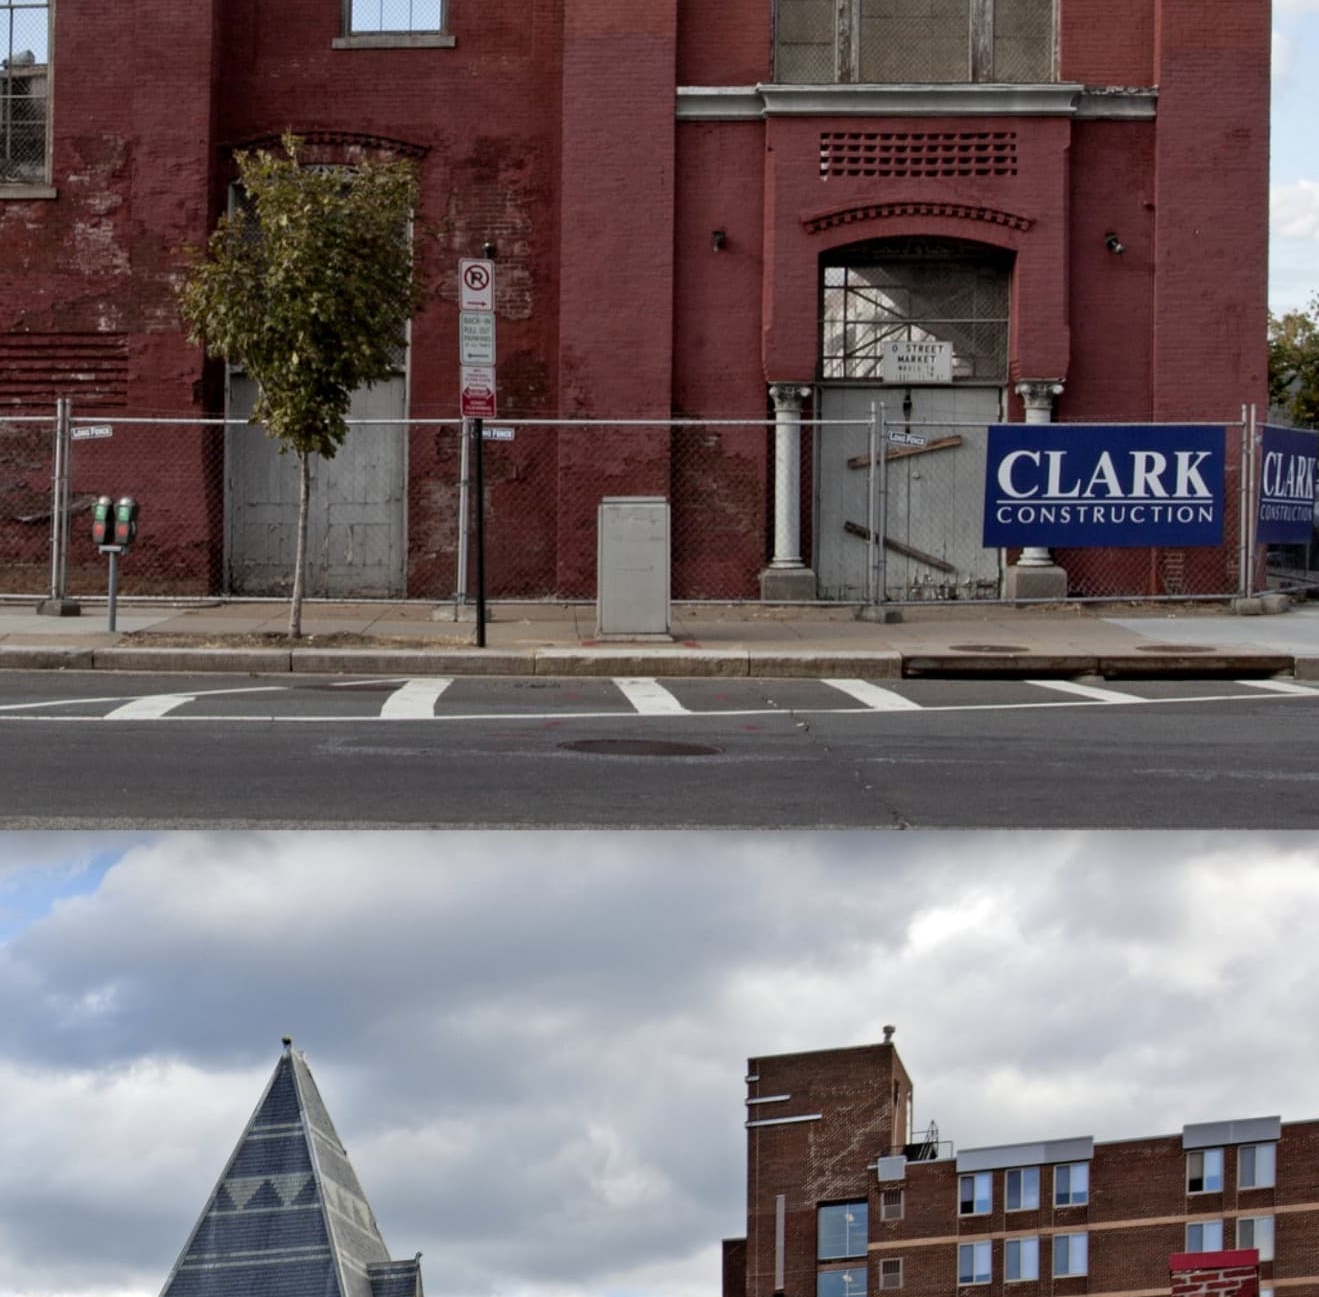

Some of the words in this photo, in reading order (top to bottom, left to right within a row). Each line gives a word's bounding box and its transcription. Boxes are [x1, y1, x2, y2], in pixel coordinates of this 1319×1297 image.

[905, 344, 945, 353] STREET
[897, 355, 937, 363] MARKET
[996, 450, 1213, 499] CLARK
[1263, 451, 1316, 499] CLARK
[996, 506, 1214, 524] CONSTRUCTION
[1260, 504, 1313, 521] CONSTRUCTION
